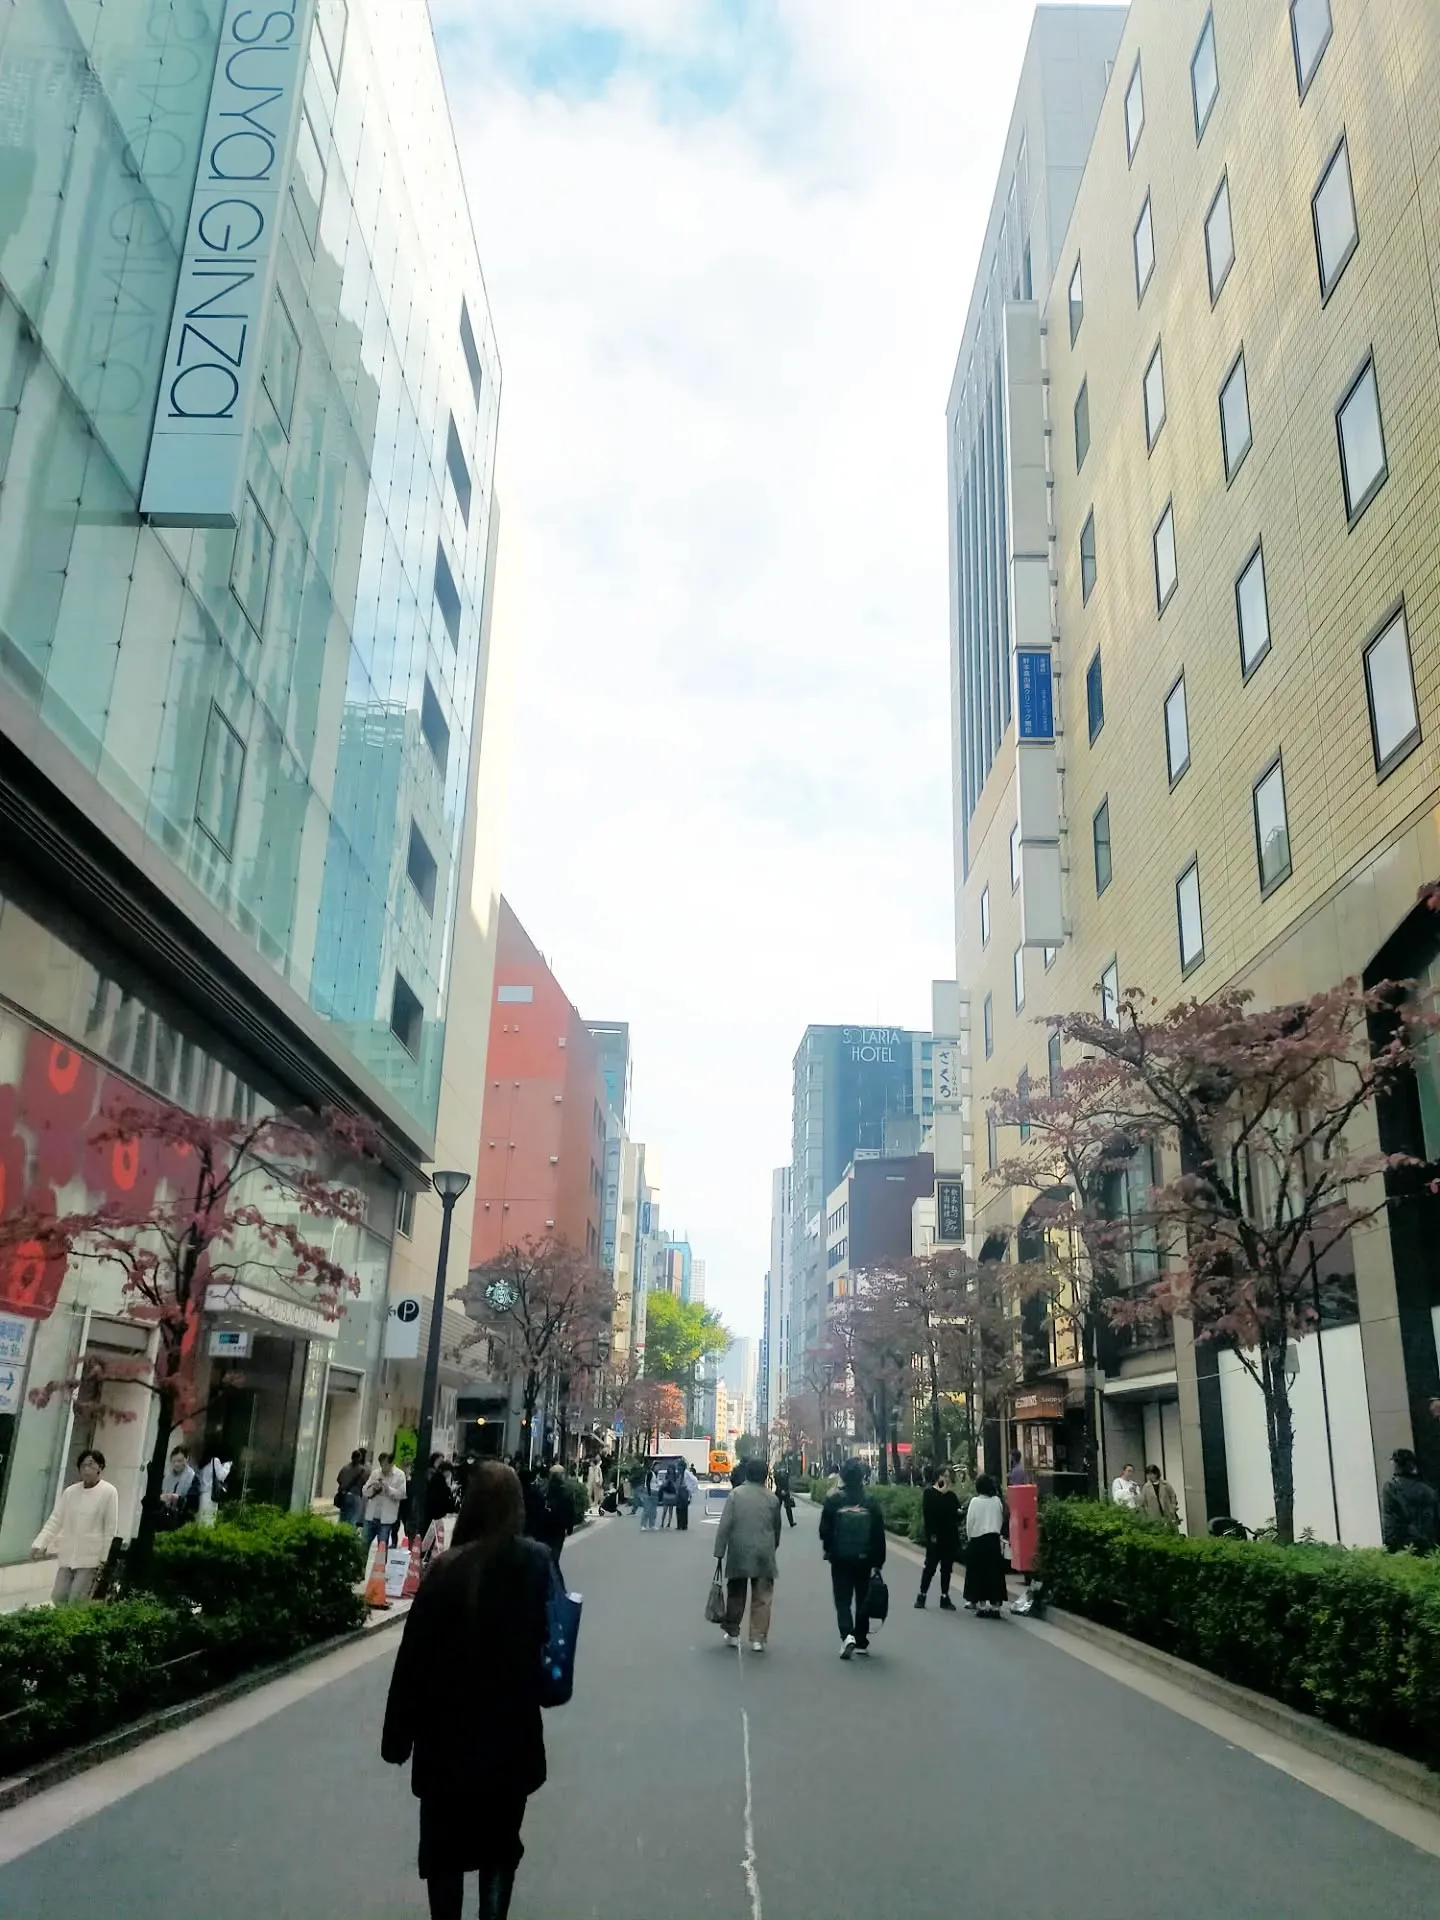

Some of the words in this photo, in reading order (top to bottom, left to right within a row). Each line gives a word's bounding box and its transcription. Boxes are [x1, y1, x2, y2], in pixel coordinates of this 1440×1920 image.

[842, 1028, 901, 1045] SOLARIA
[851, 1046, 896, 1063] HOTEL
[402, 1300, 416, 1321] P
